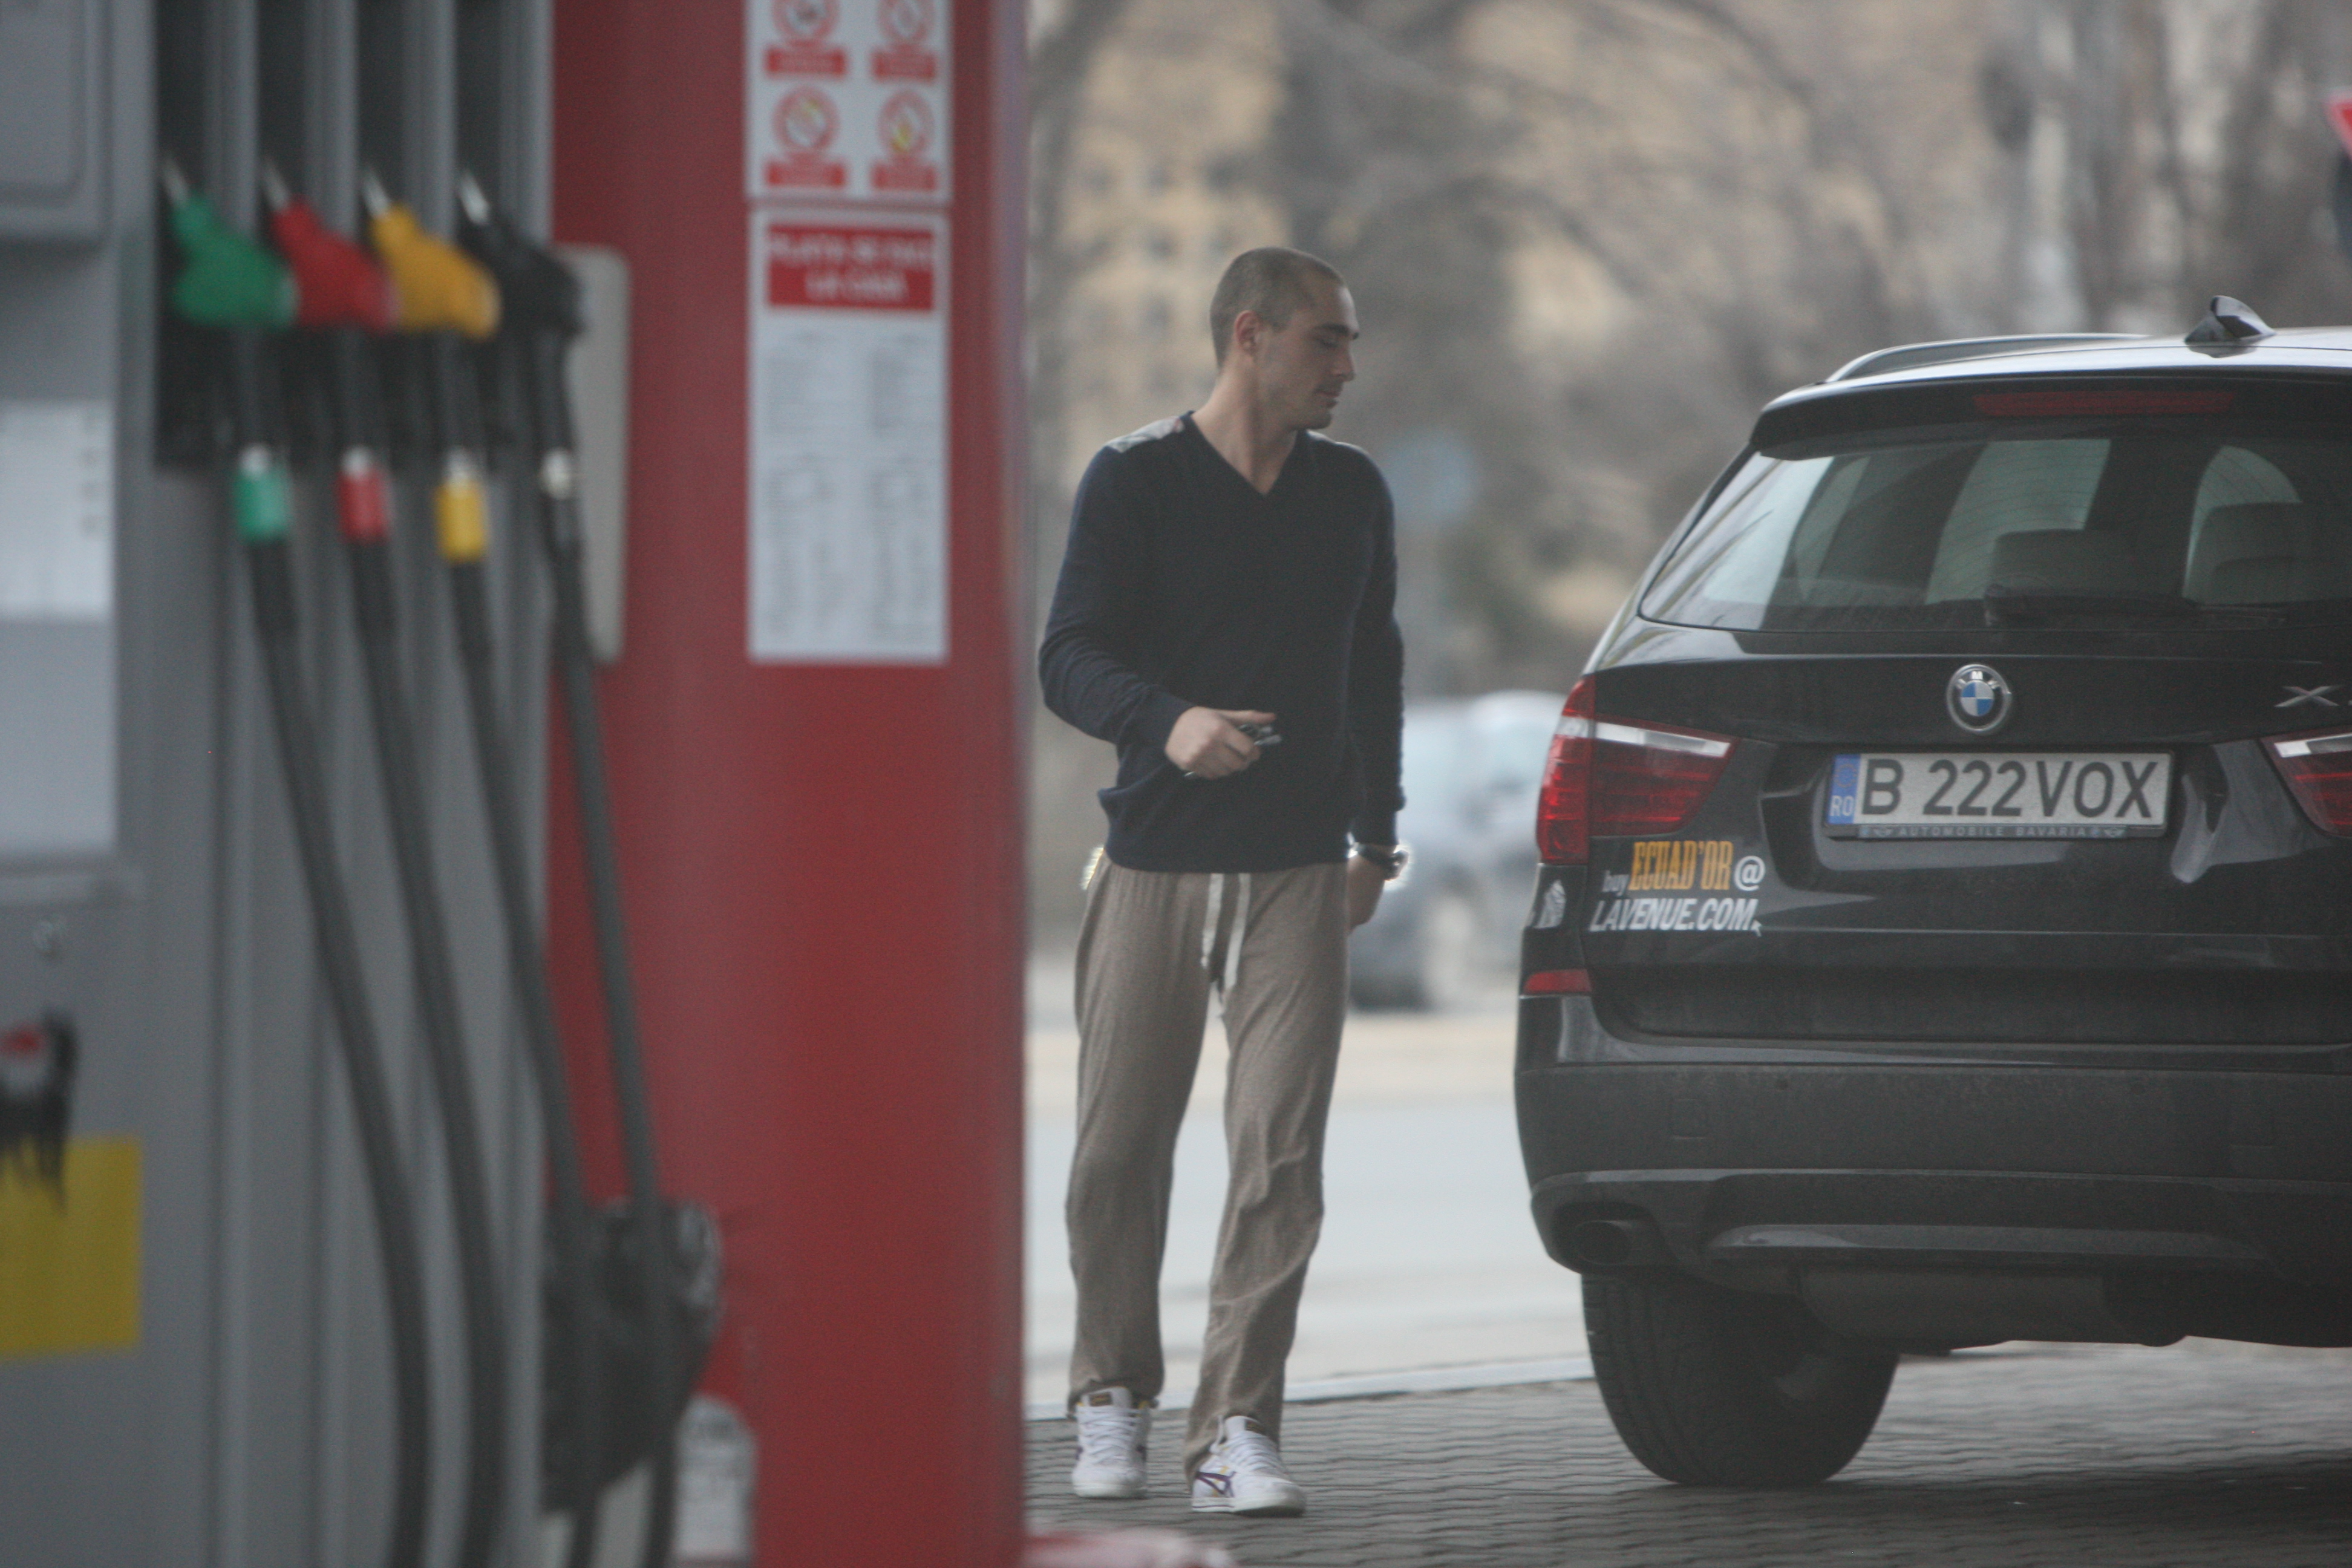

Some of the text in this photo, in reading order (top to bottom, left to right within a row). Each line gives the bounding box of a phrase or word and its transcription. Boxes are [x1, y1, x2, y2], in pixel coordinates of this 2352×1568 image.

[1861, 759, 1904, 815] B
[1829, 795, 1856, 817] RO
[1898, 826, 2086, 837] AUTOMOBILE BAVARIA
[1734, 855, 1766, 891] @
[1589, 898, 1759, 932] LAVENUE.COM
